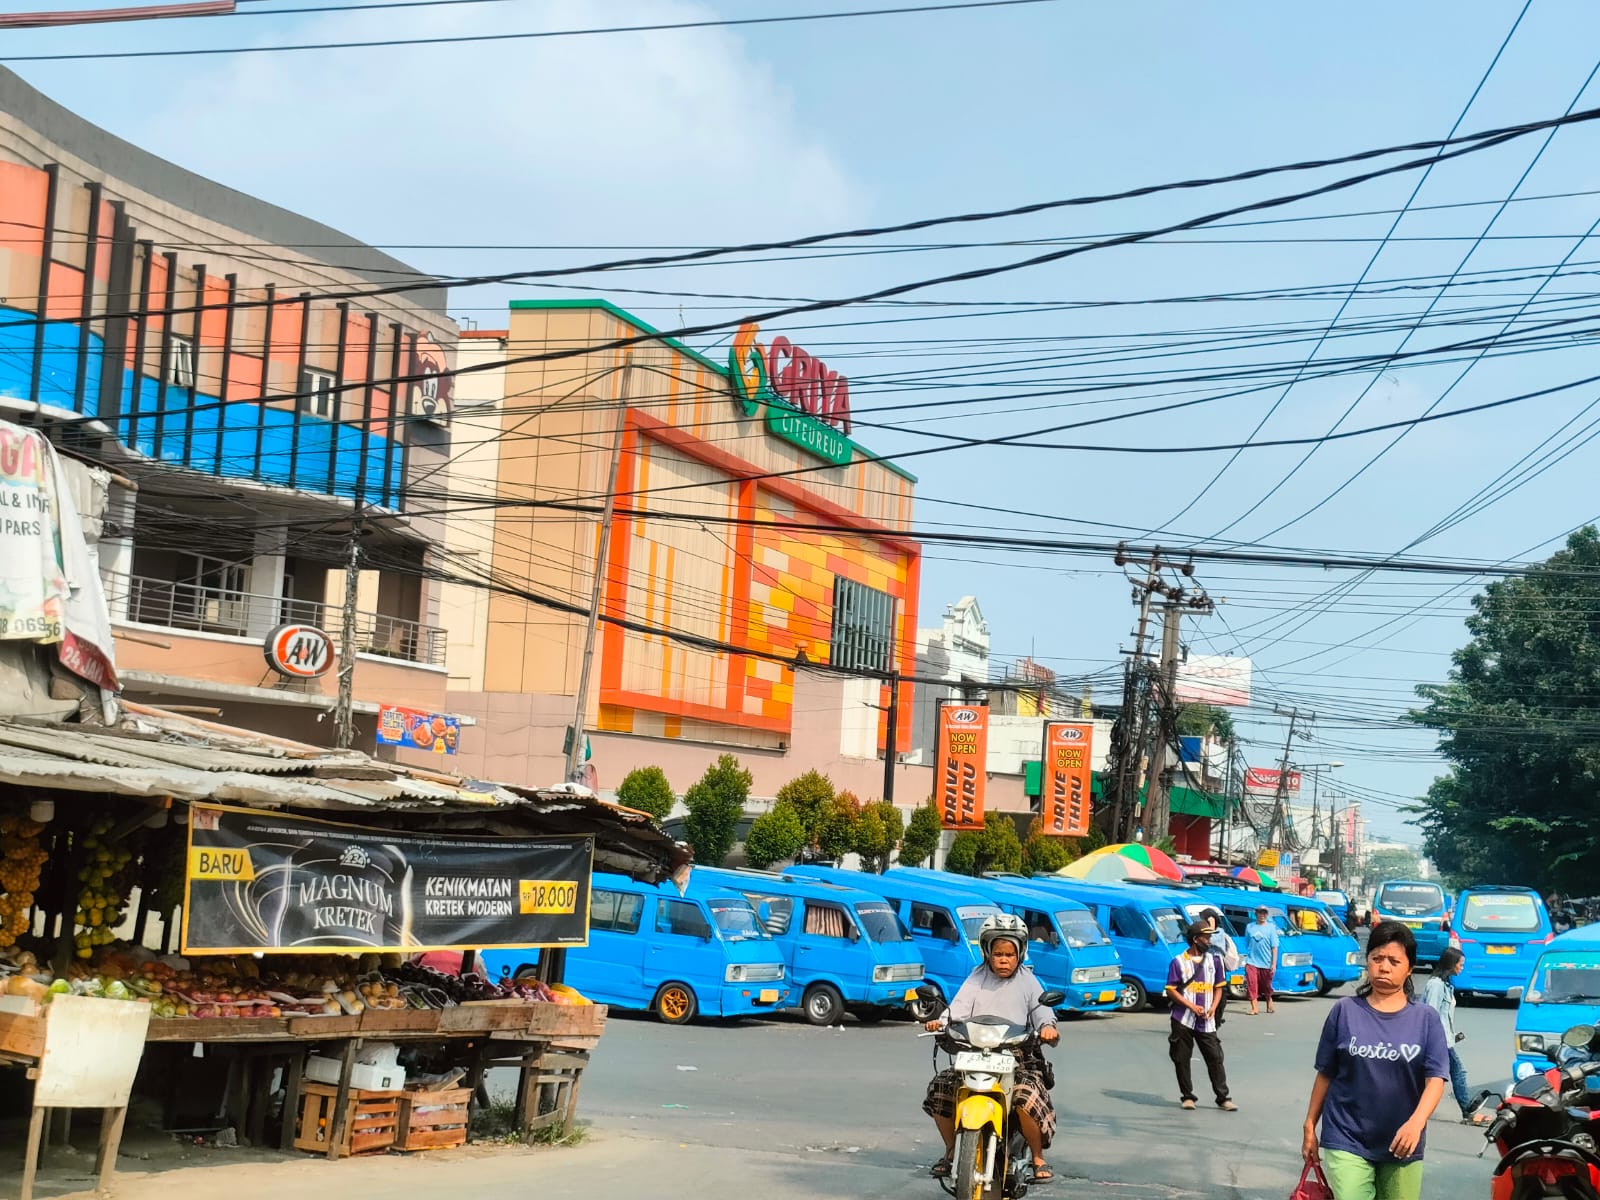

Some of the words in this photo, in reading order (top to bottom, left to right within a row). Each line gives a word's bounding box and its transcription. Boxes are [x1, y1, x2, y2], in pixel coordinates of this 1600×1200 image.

[769, 335, 852, 435] GRIYA
[782, 413, 843, 460] CITEUREUP
[63, 645, 81, 669] 24
[950, 744, 976, 754] OPEN
[951, 733, 976, 743] NOW
[1057, 749, 1082, 758] NOW
[1057, 759, 1083, 769] OPEN
[944, 757, 959, 826] DRIVE
[961, 762, 977, 825] THRU
[1053, 771, 1067, 833] DRIVE
[1068, 776, 1083, 832] THRU
[199, 852, 244, 874] BARU
[299, 874, 393, 918] MAGNUM
[425, 877, 512, 897] KENIKMATAN
[313, 906, 377, 934] KRETEK
[425, 900, 465, 916] KRETEK
[468, 900, 513, 916] MODERN
[1348, 1036, 1401, 1062] bestie
